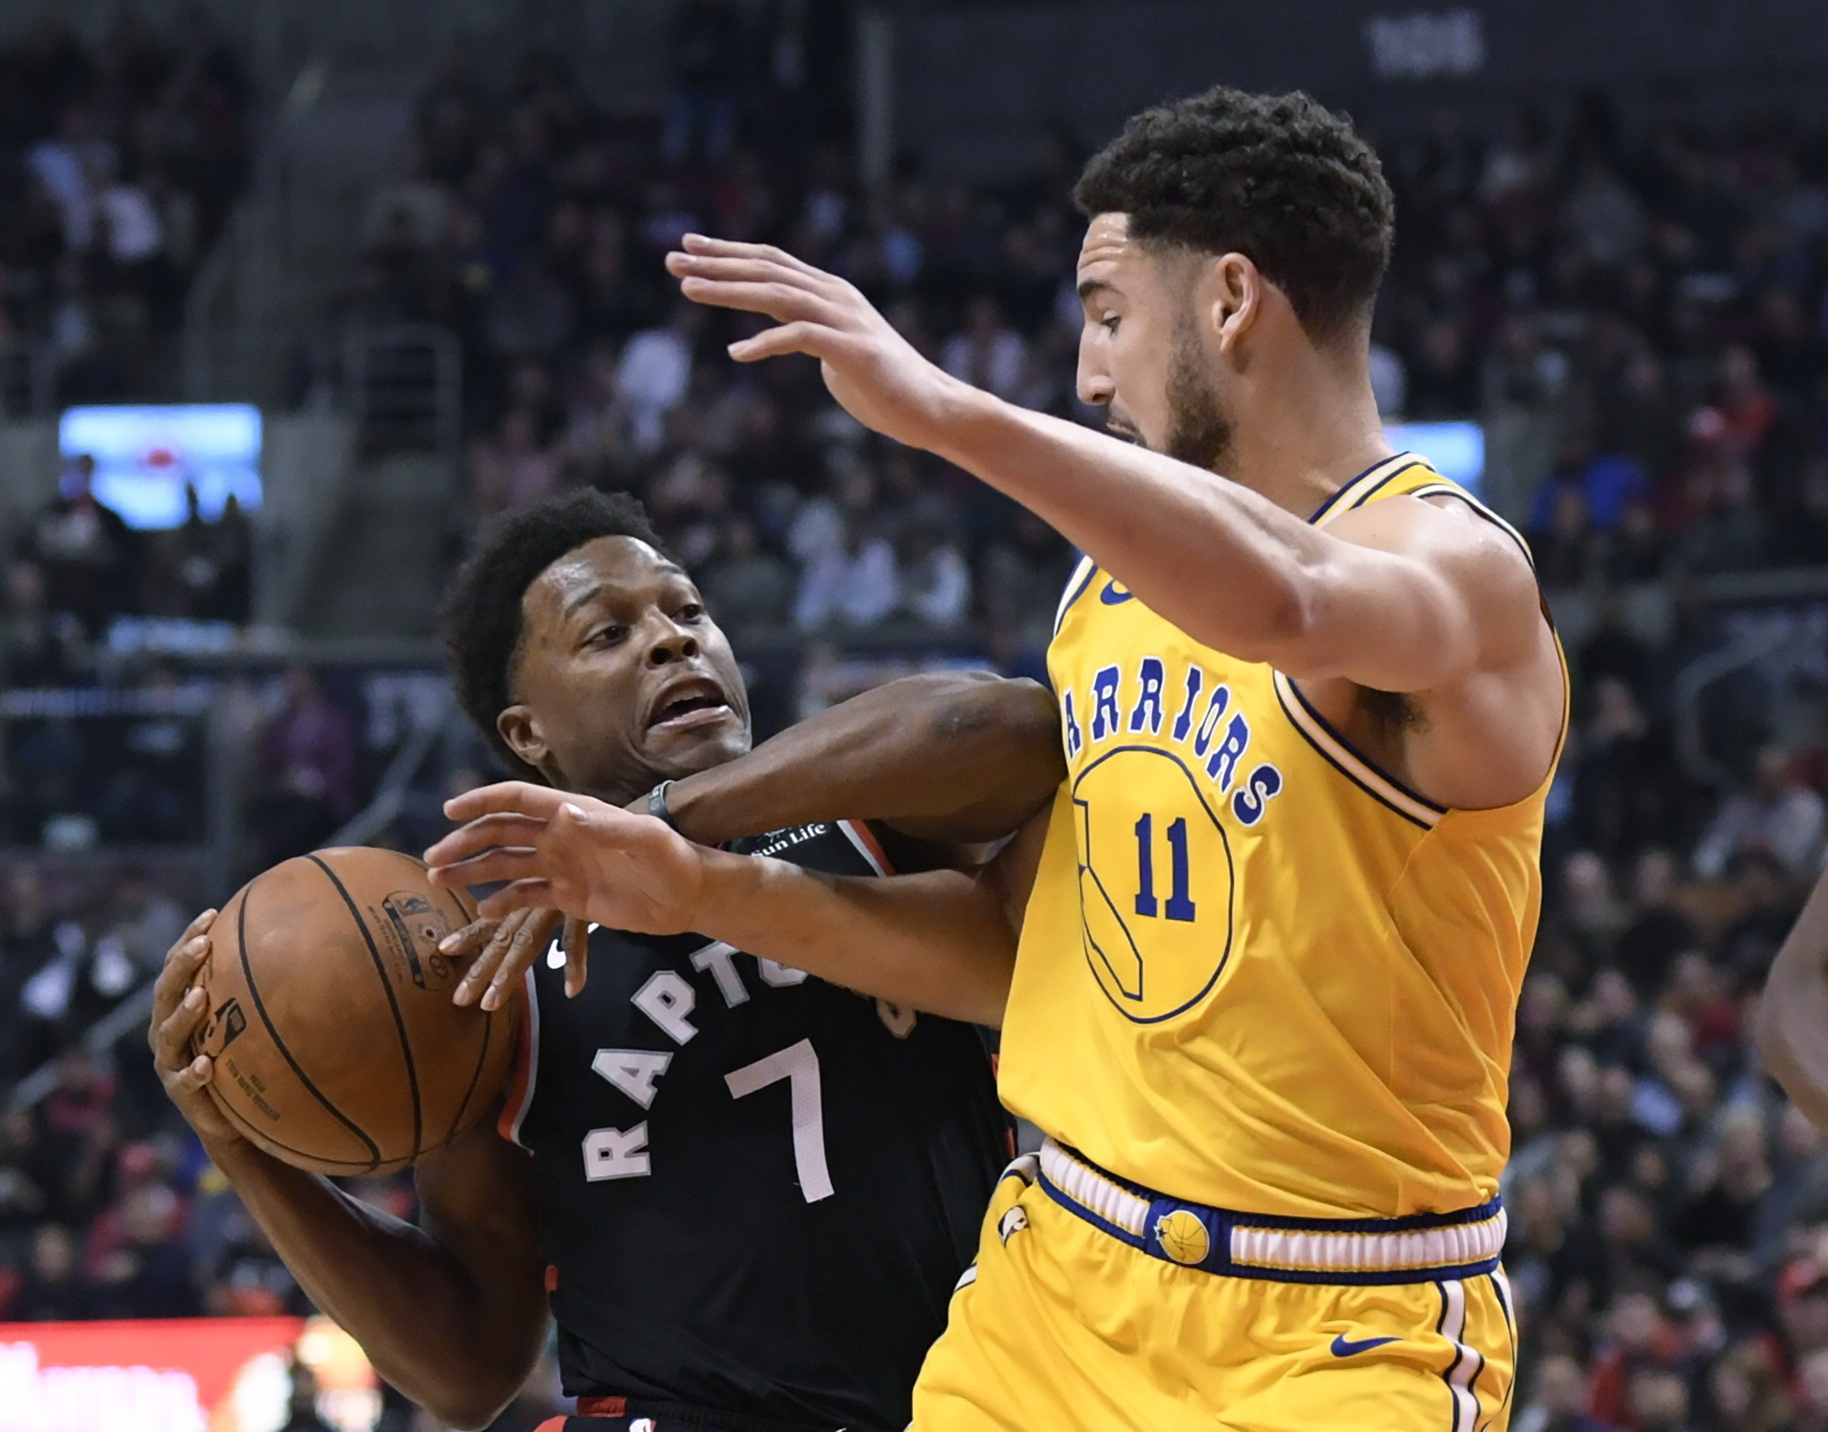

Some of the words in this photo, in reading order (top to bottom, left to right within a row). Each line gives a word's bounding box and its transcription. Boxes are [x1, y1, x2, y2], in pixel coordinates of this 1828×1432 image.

[1063, 657, 1282, 827] ARRIORS
[750, 840, 788, 857] Sun
[789, 823, 827, 844] Life
[1135, 813, 1195, 922] 11
[582, 941, 916, 1182] RAPT
[724, 1038, 834, 1203] 7
